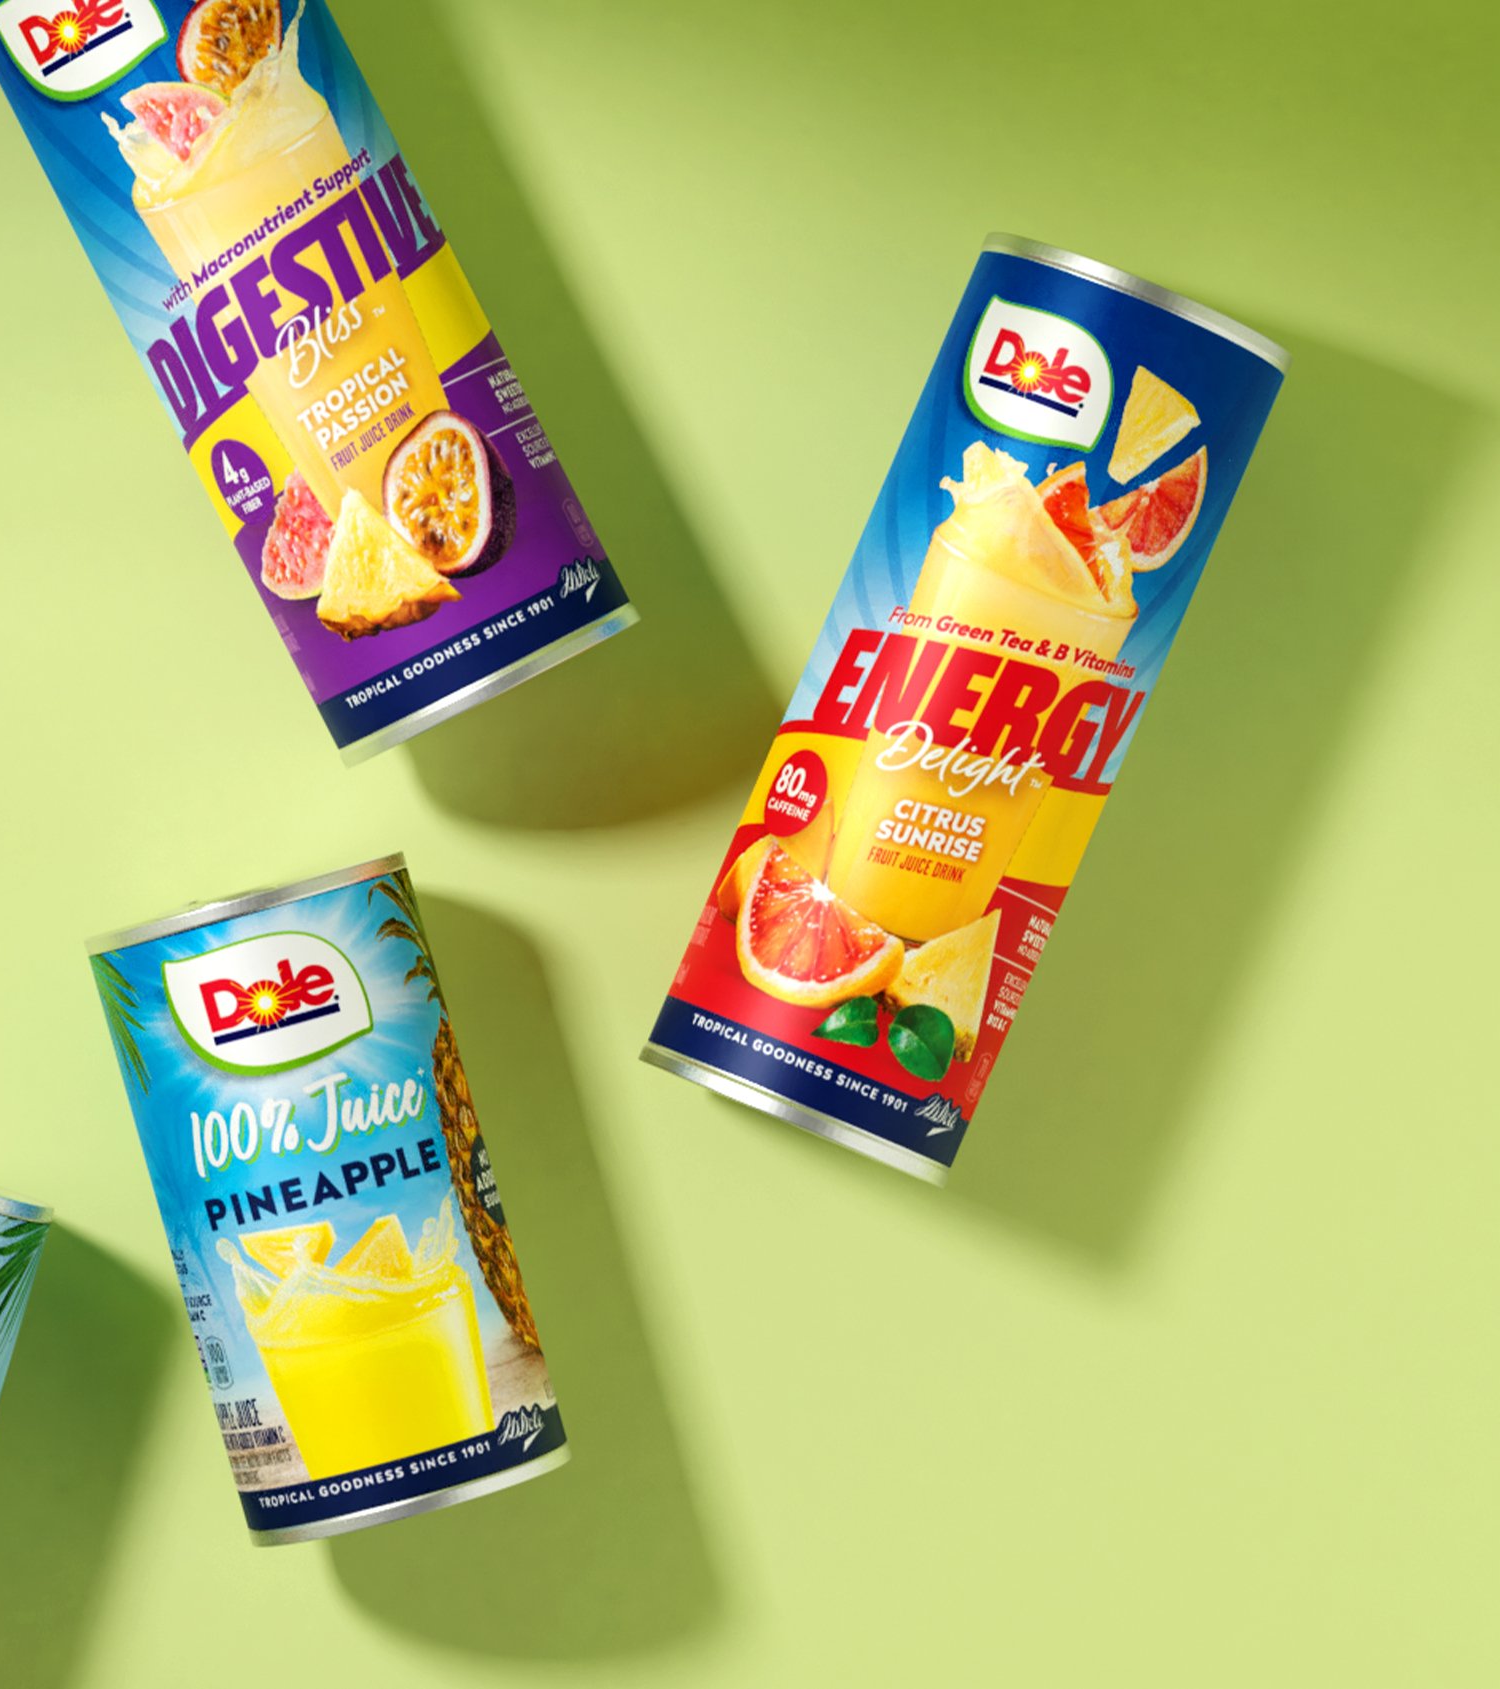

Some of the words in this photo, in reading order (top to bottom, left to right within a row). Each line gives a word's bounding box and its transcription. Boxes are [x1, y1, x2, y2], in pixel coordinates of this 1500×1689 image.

[18, 0, 124, 66] Dole
[162, 281, 192, 312] with
[190, 189, 315, 289] Macronutrient
[313, 148, 371, 200] Support
[147, 153, 446, 434] DIGESTIVE
[275, 297, 363, 389] Bliss
[983, 328, 1091, 404] Dole
[297, 348, 406, 432] TROPICAL
[315, 372, 410, 451] PASSION
[222, 450, 250, 484] 4g
[330, 441, 360, 472] FRUIT
[359, 422, 387, 452] JUICE
[384, 402, 416, 432] DRINK
[241, 496, 263, 515] FIBER
[345, 675, 402, 709] TROPICAL
[403, 632, 481, 681] GOODNESS
[484, 611, 526, 640] SINCE
[527, 596, 555, 618] 1901
[888, 606, 932, 630] From
[936, 615, 994, 643] Green
[1000, 629, 1031, 652] Tea
[1035, 639, 1051, 658] &
[1053, 644, 1070, 661] B
[1073, 647, 1136, 679] Vitamins
[813, 628, 1146, 786] ENERGY
[775, 763, 817, 807] 80mg
[875, 719, 1047, 798] Delight
[767, 797, 811, 822] CAFFEINE
[875, 819, 984, 862] SUNRISE
[894, 799, 986, 837] CITRUS
[867, 846, 900, 868] FRUIT
[900, 853, 932, 876] JUICE
[932, 861, 966, 884] DRINK
[199, 959, 335, 1033] Dole
[692, 1013, 748, 1047] TROPICAL
[752, 1039, 833, 1081] GOODNESS
[836, 1073, 878, 1100] SINCE
[882, 1093, 908, 1113] 1901
[190, 1098, 300, 1179] 100%
[204, 1138, 442, 1232] PINEAPPLE
[235, 1398, 262, 1429] JUICE
[277, 1425, 286, 1443] C
[258, 1489, 315, 1510] TROPICAL
[319, 1466, 404, 1498] GOODNESS
[410, 1451, 457, 1476] SINCE
[461, 1440, 491, 1460] 1901
